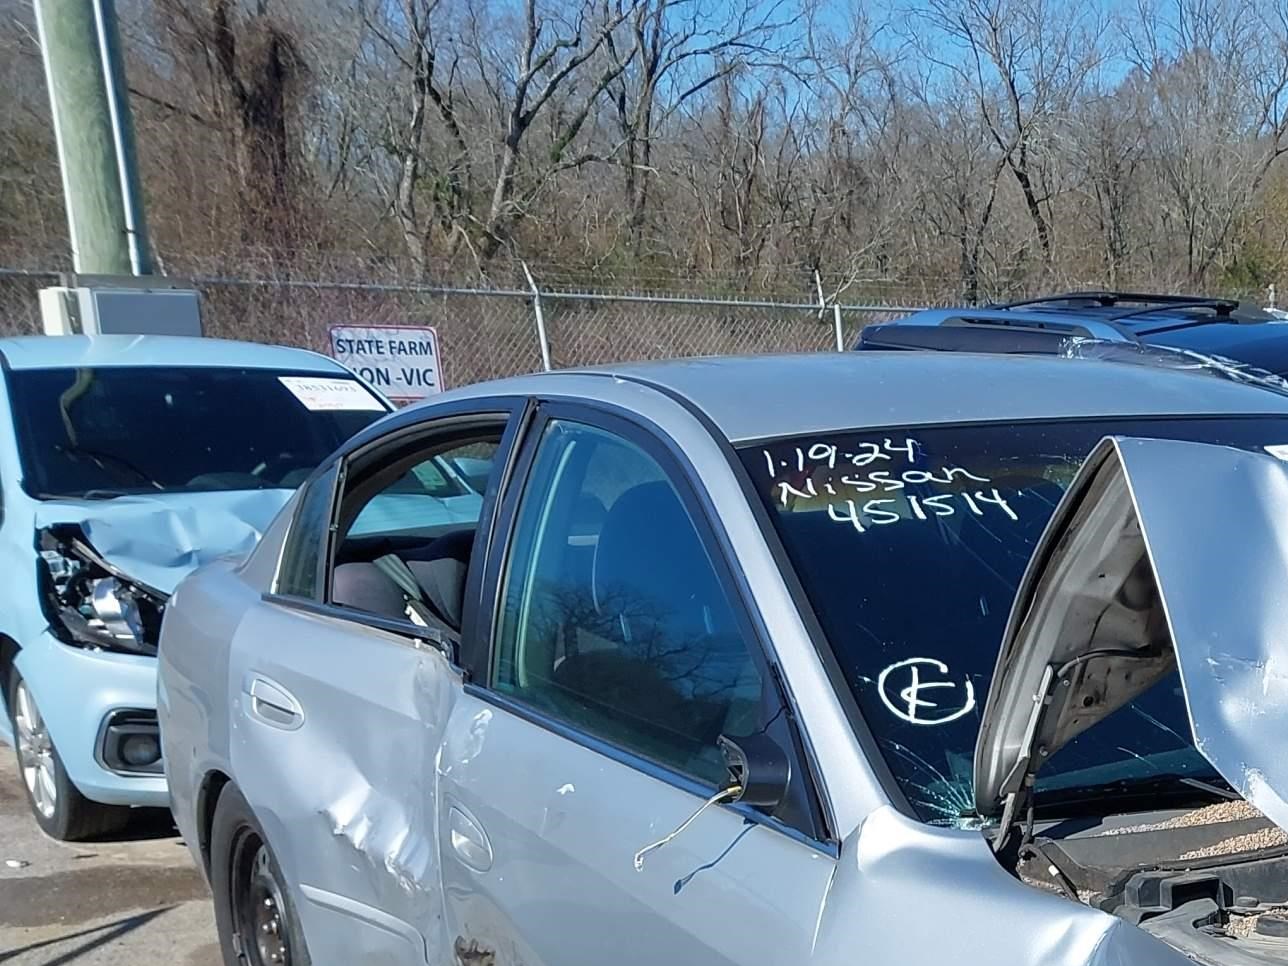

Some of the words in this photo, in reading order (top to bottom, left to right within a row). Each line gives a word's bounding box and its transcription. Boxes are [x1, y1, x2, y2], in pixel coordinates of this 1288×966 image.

[336, 339, 385, 354] STATE
[388, 340, 433, 356] FARM
[353, 367, 391, 386] ON
[395, 368, 435, 387] -VIC
[828, 489, 1018, 532] 451514
